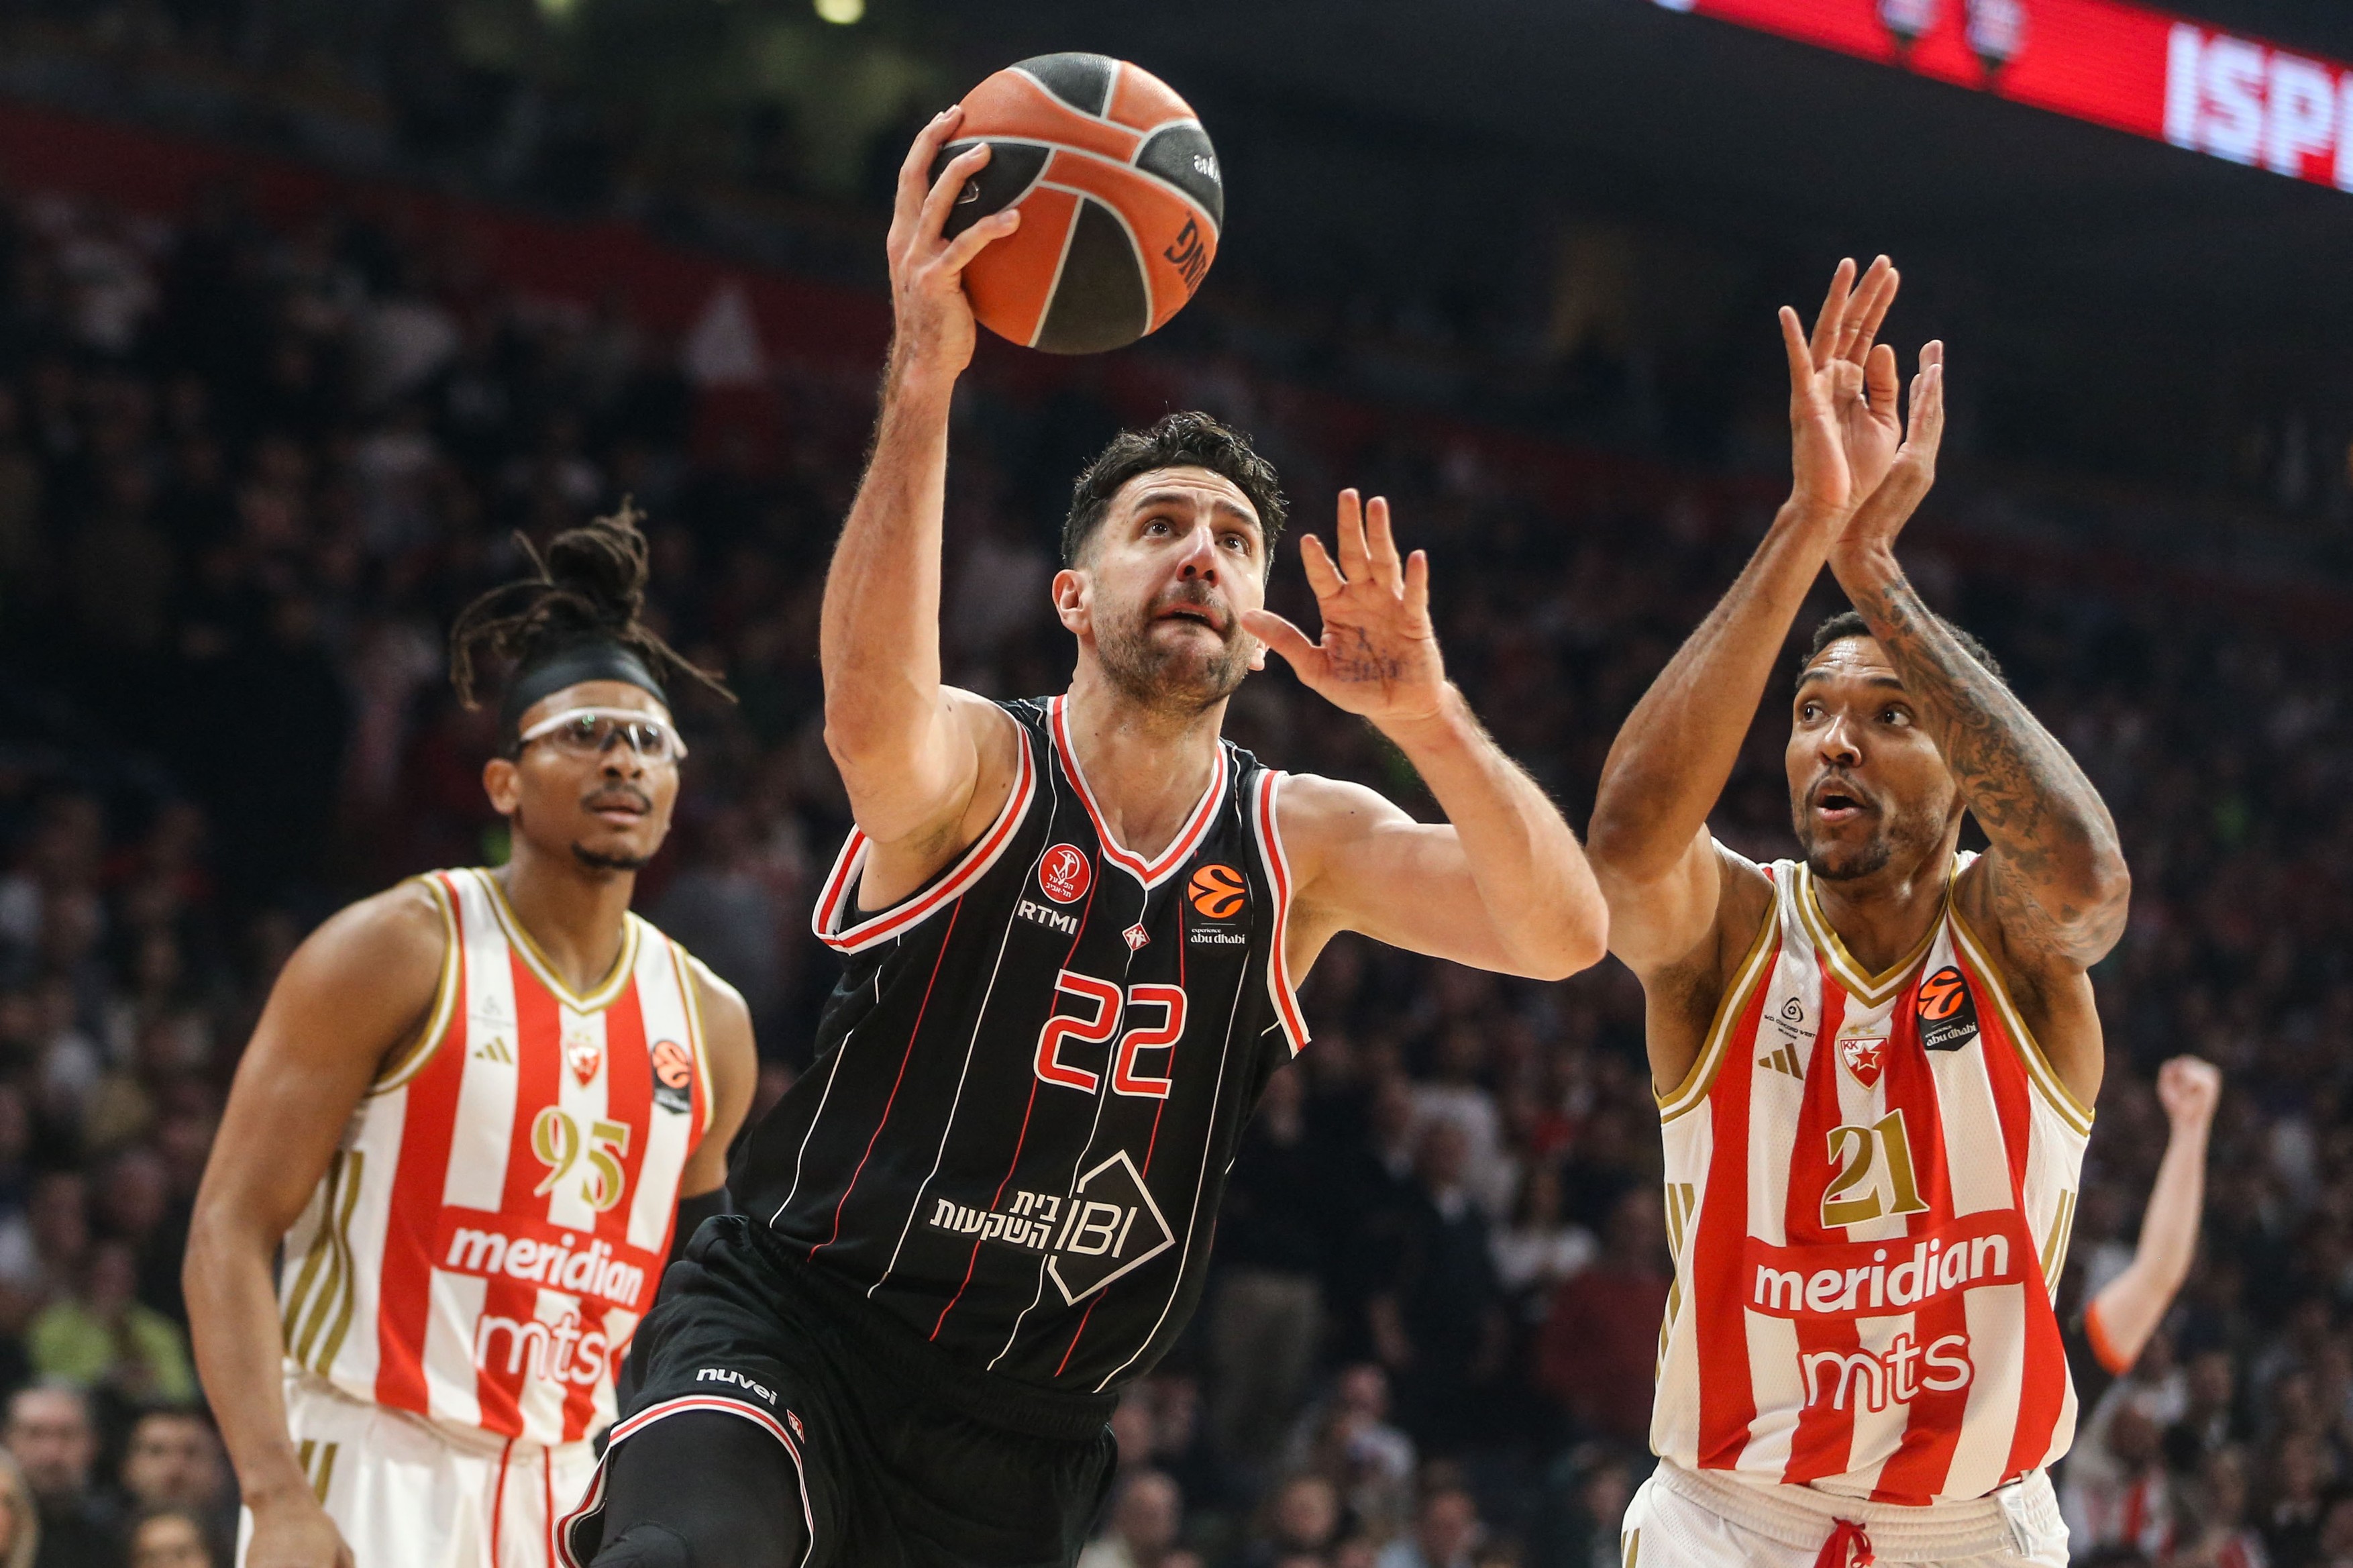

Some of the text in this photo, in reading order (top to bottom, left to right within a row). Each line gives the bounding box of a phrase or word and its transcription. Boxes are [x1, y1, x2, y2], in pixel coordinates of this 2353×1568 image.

[2162, 22, 2353, 194] ISP
[1018, 900, 1078, 935] RTMI
[1190, 933, 1245, 944] abu dhabi
[1033, 968, 1188, 1099] 22
[1926, 1022, 1977, 1047] abu dhabi
[532, 1106, 631, 1211] 95
[1820, 1108, 1930, 1230] 21
[930, 1198, 1052, 1249] השקעות
[1009, 1191, 1061, 1222] בית
[1054, 1199, 1138, 1258] IBI
[446, 1227, 643, 1306] meridian
[1753, 1233, 2009, 1313] meridian
[476, 1310, 607, 1385] mts
[1802, 1335, 1971, 1409] mts
[696, 1367, 778, 1406] nuvei
